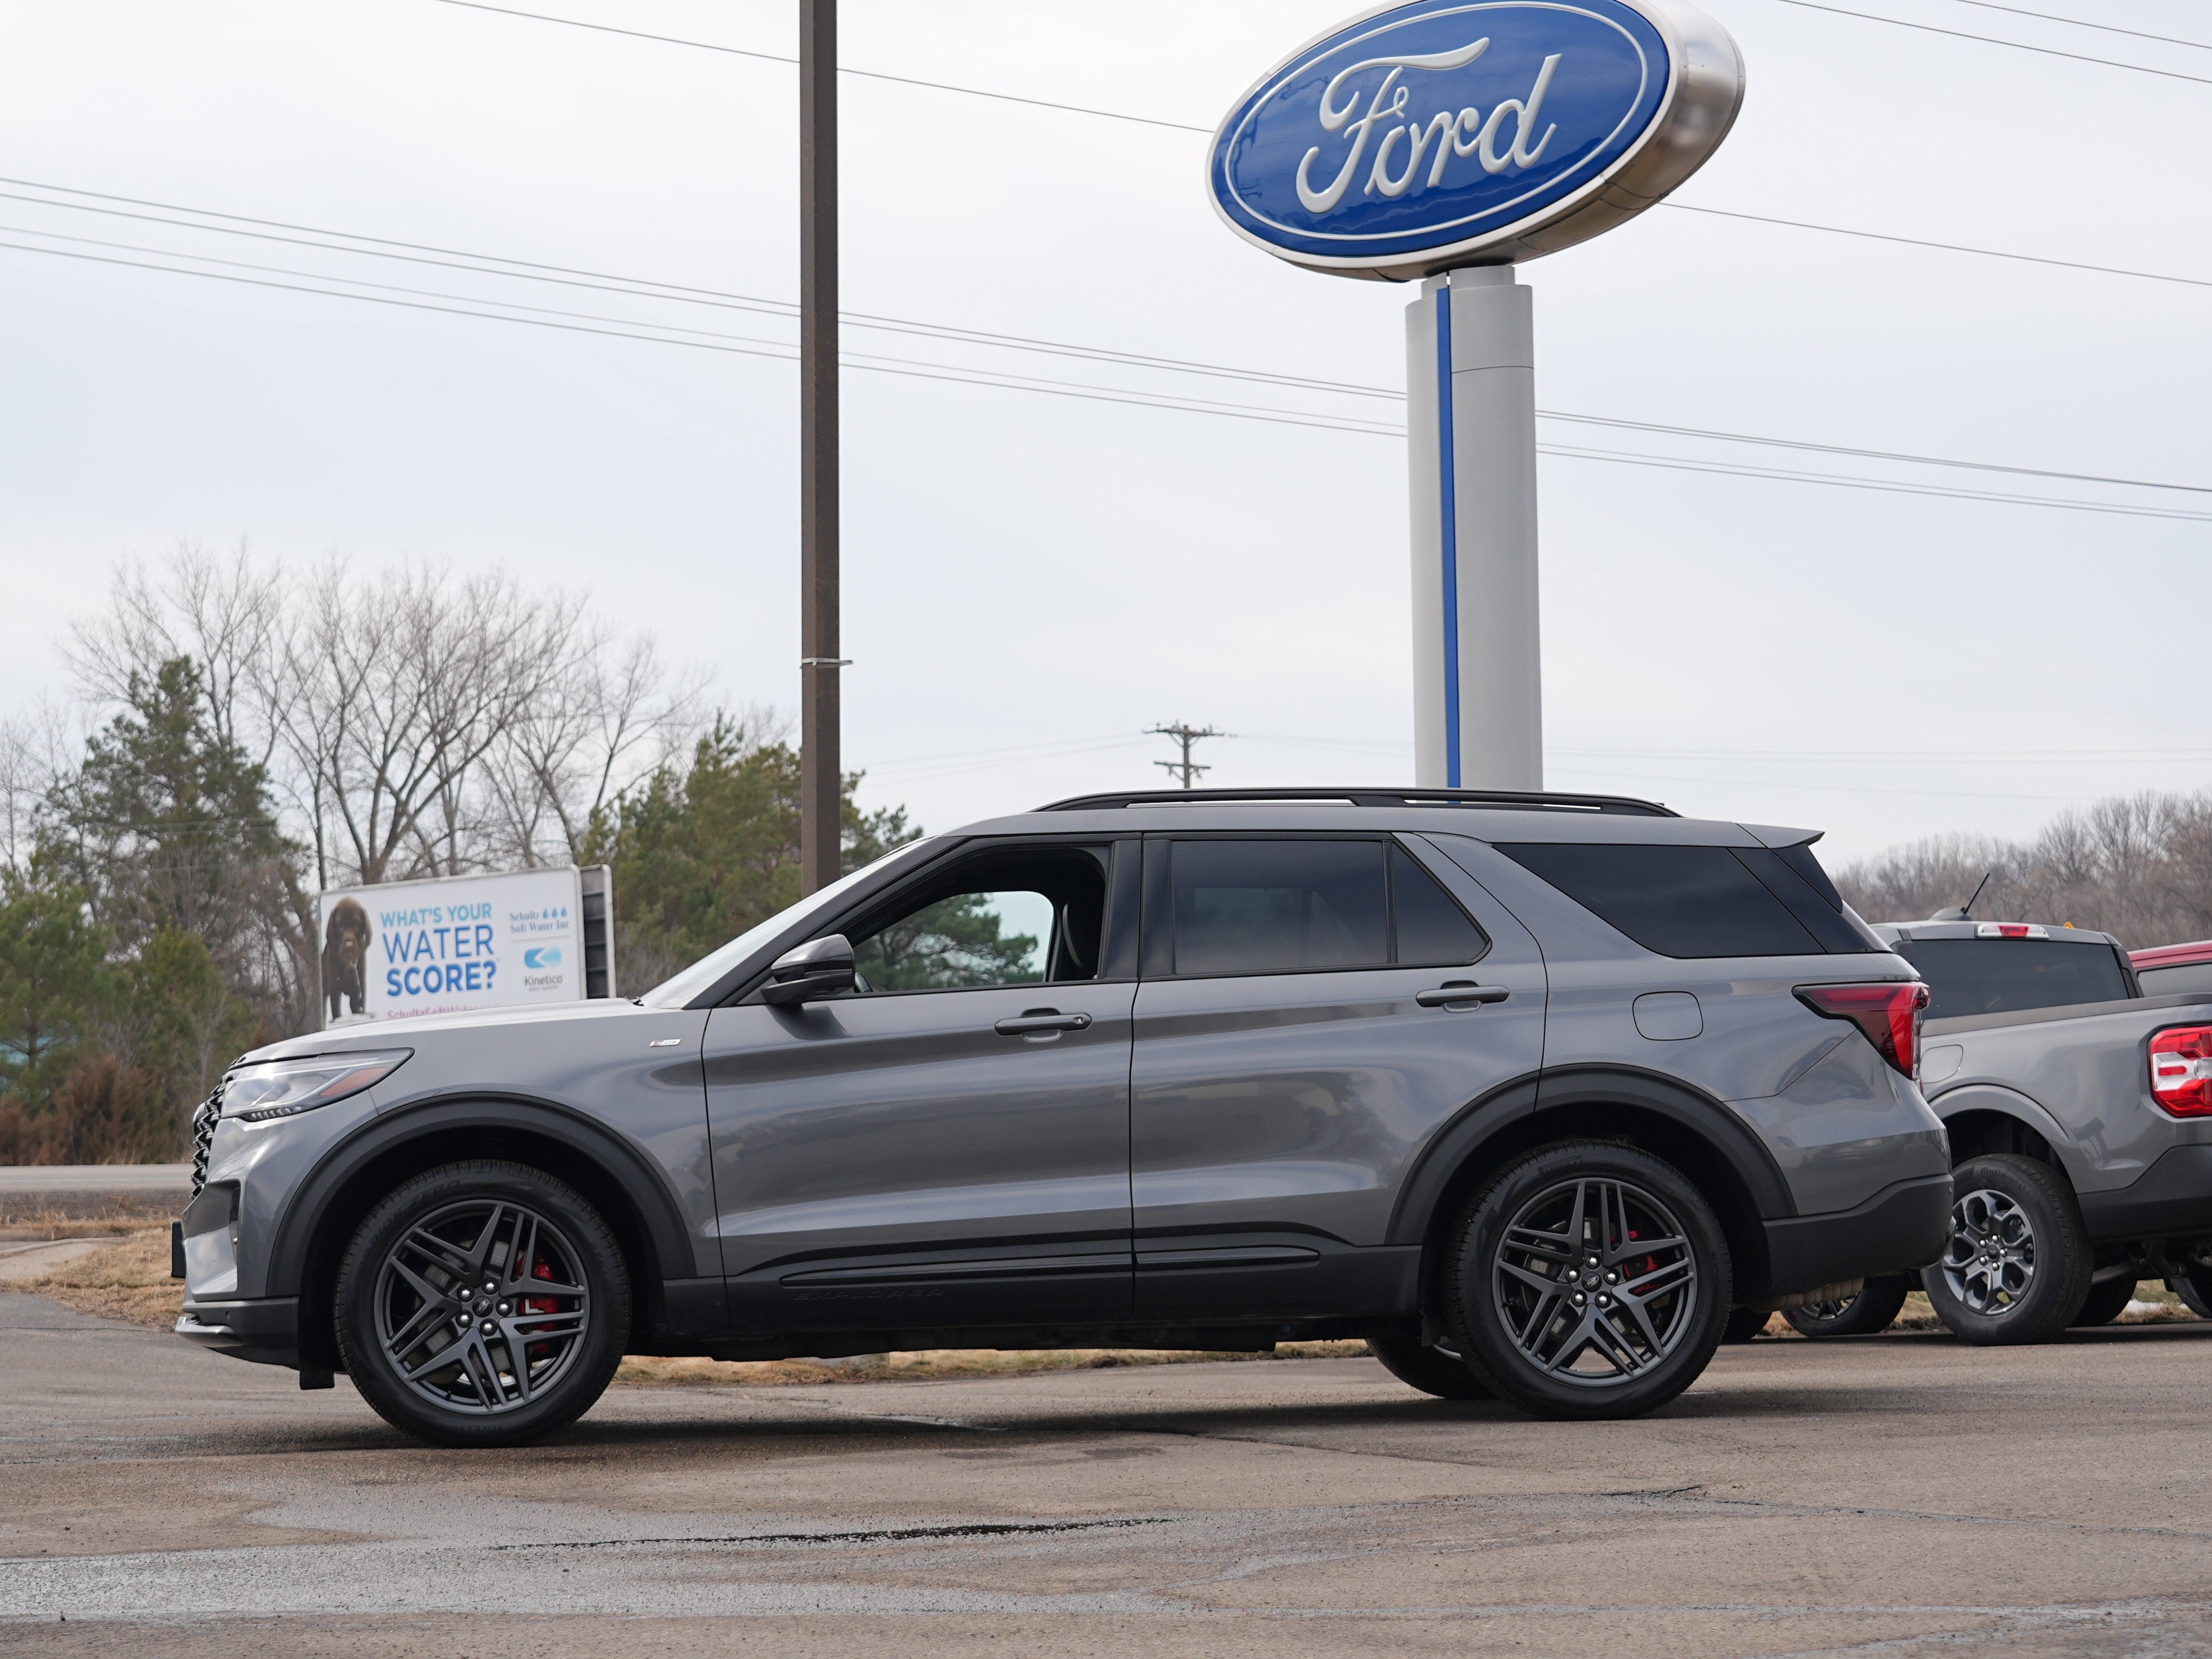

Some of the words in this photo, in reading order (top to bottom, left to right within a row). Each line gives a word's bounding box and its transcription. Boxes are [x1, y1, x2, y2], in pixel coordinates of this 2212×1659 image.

[1297, 37, 1562, 213] Ford
[380, 907, 443, 928] WHAT'S
[447, 902, 493, 922] YOUR
[529, 921, 554, 930] Water
[382, 923, 494, 963] WATER
[387, 960, 497, 996] SCORE?
[525, 974, 563, 986] Kinetico
